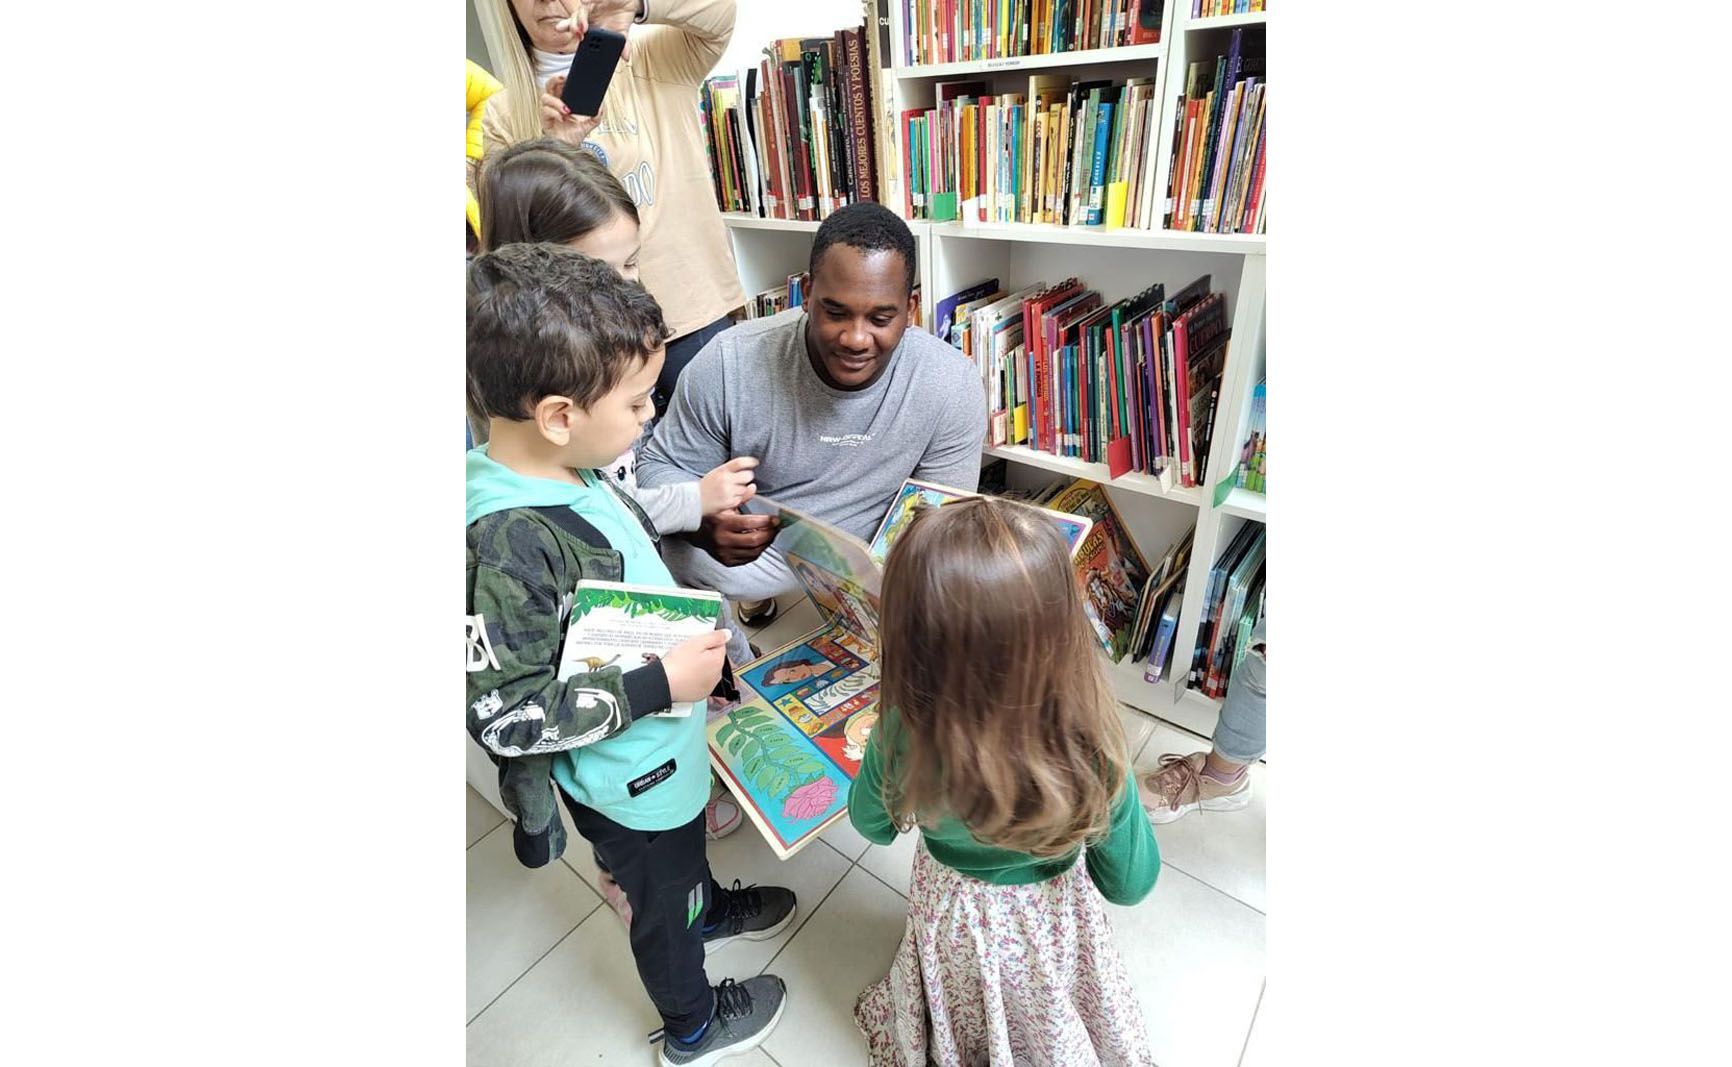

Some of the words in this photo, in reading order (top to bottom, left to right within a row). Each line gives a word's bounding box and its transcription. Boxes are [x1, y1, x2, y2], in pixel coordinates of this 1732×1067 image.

[853, 93, 866, 135] CUENTOS
[857, 138, 869, 179] MEJORES
[860, 181, 870, 197] LOS
